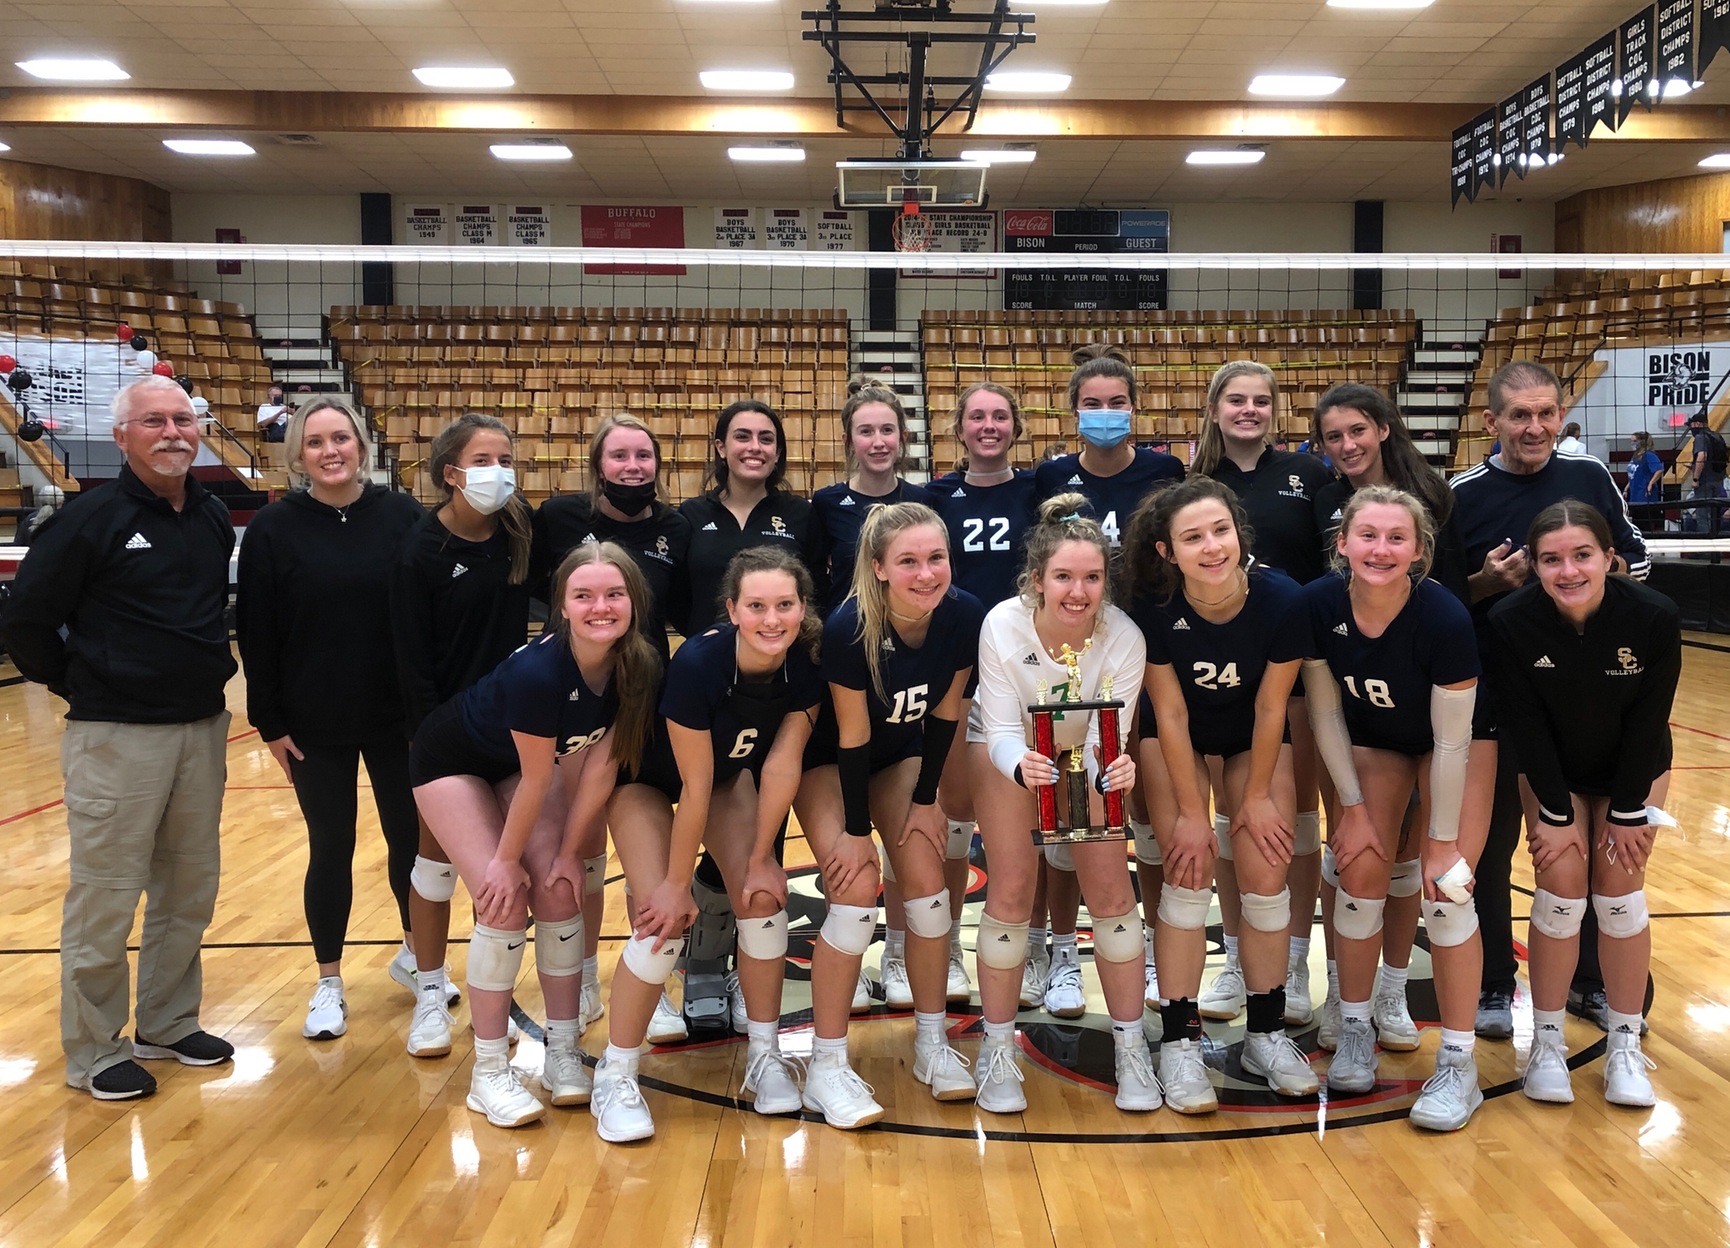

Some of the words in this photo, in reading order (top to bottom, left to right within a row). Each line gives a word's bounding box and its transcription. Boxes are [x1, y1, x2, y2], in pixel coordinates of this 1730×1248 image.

[1628, 19, 1644, 39] GIRLS
[1661, 11, 1692, 40] DISTRICT
[1626, 33, 1646, 54] TRACK
[1662, 31, 1690, 56] CHAMPS
[1586, 45, 1614, 70] SOFTBALL
[1668, 53, 1684, 71] 1982
[1557, 66, 1583, 89] SOFTBALL
[1586, 62, 1612, 86] DISTRICT
[1624, 62, 1648, 84] CHAMPS
[1558, 82, 1581, 104] DISTRICT
[1587, 80, 1610, 101] CHAMPS
[1524, 94, 1550, 116] BASKETBALL
[1559, 99, 1580, 118] CHAMPS
[1474, 119, 1494, 137] FOOTBALL
[1500, 110, 1523, 132] BASKETBALL
[1526, 122, 1545, 140] CHAMPS
[1476, 148, 1492, 163] CHAMPS
[1502, 138, 1520, 154] CHAMPS
[608, 208, 656, 218] BUFFALO
[1017, 238, 1045, 248] BISON
[1126, 238, 1156, 248] GUEST
[1650, 352, 1710, 374] BISON
[1649, 383, 1710, 406] PRIDE
[762, 531, 795, 540] VOLLEYBALL
[963, 517, 1010, 552] 22
[1193, 661, 1242, 690] 24
[1051, 682, 1068, 720] 7
[1344, 675, 1396, 708] 18
[886, 684, 929, 724] 15
[728, 728, 758, 758] 6
